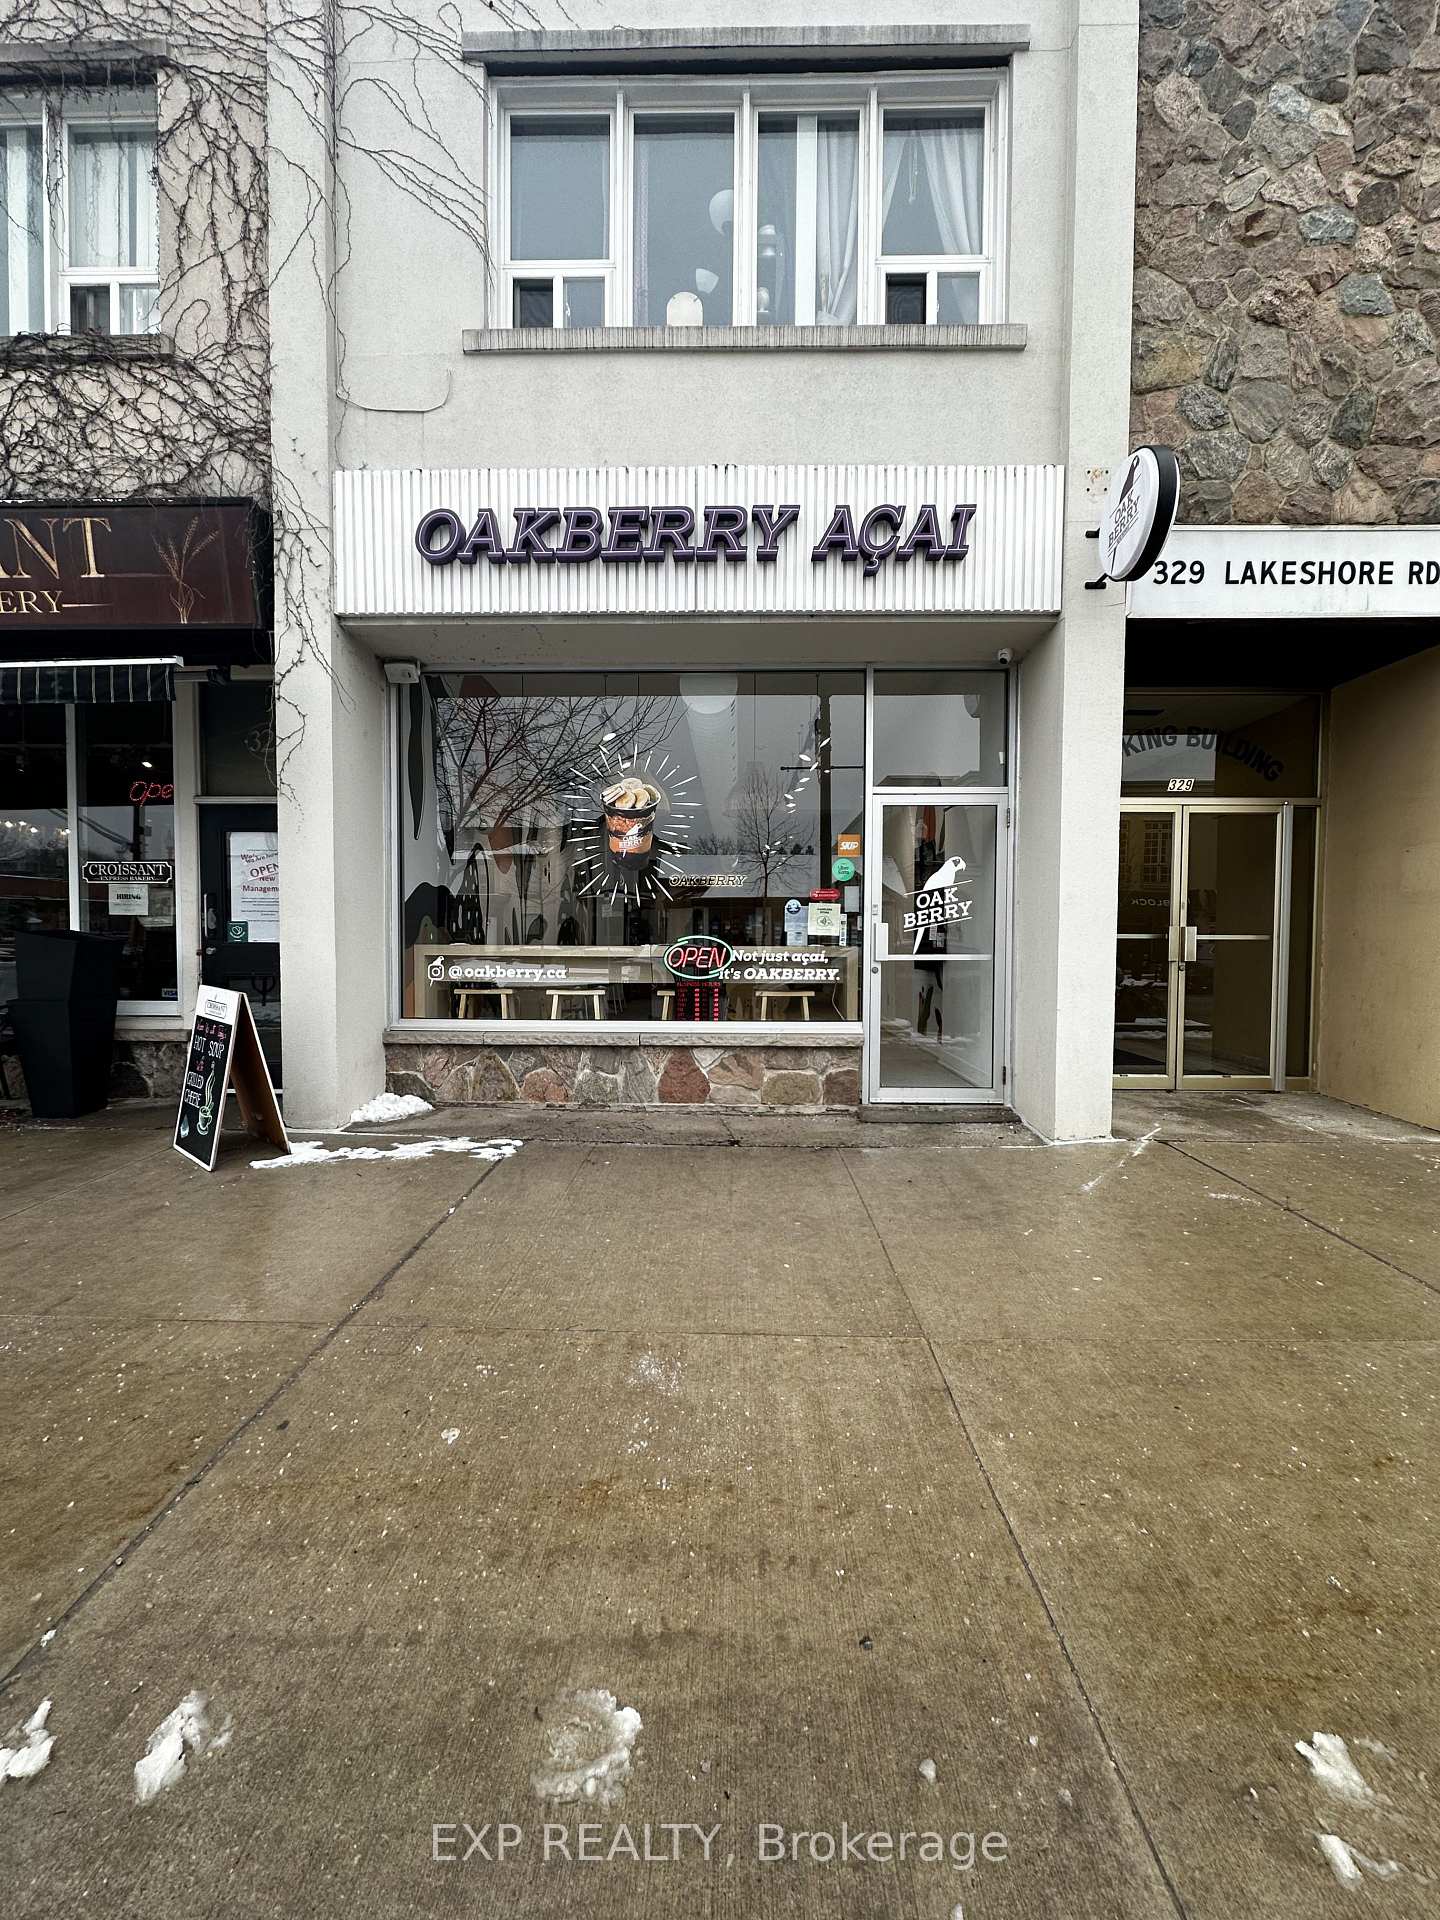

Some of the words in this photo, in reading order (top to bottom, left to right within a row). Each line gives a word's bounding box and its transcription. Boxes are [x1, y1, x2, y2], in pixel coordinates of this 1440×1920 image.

[1114, 488, 1134, 524] OAK
[1108, 496, 1140, 547] BERRY
[415, 503, 800, 565] OAKBERRY
[811, 503, 977, 577] AÇAI
[1153, 560, 1205, 585] 329
[1225, 560, 1394, 585] LAKESHORE
[1408, 560, 1440, 585] RD
[1186, 725, 1284, 781] BUILDING
[1169, 779, 1193, 791] 329
[88, 863, 166, 876] CROISSANT
[668, 873, 748, 888] OAKBERRY
[916, 886, 959, 909] OAK
[903, 900, 973, 929] BERRY
[668, 947, 727, 968] OPEN
[732, 949, 760, 962] Not
[758, 949, 792, 964] just
[791, 950, 829, 965] açai,
[448, 965, 568, 982] @oakberry.ca
[743, 967, 841, 981] OAKBERRY.
